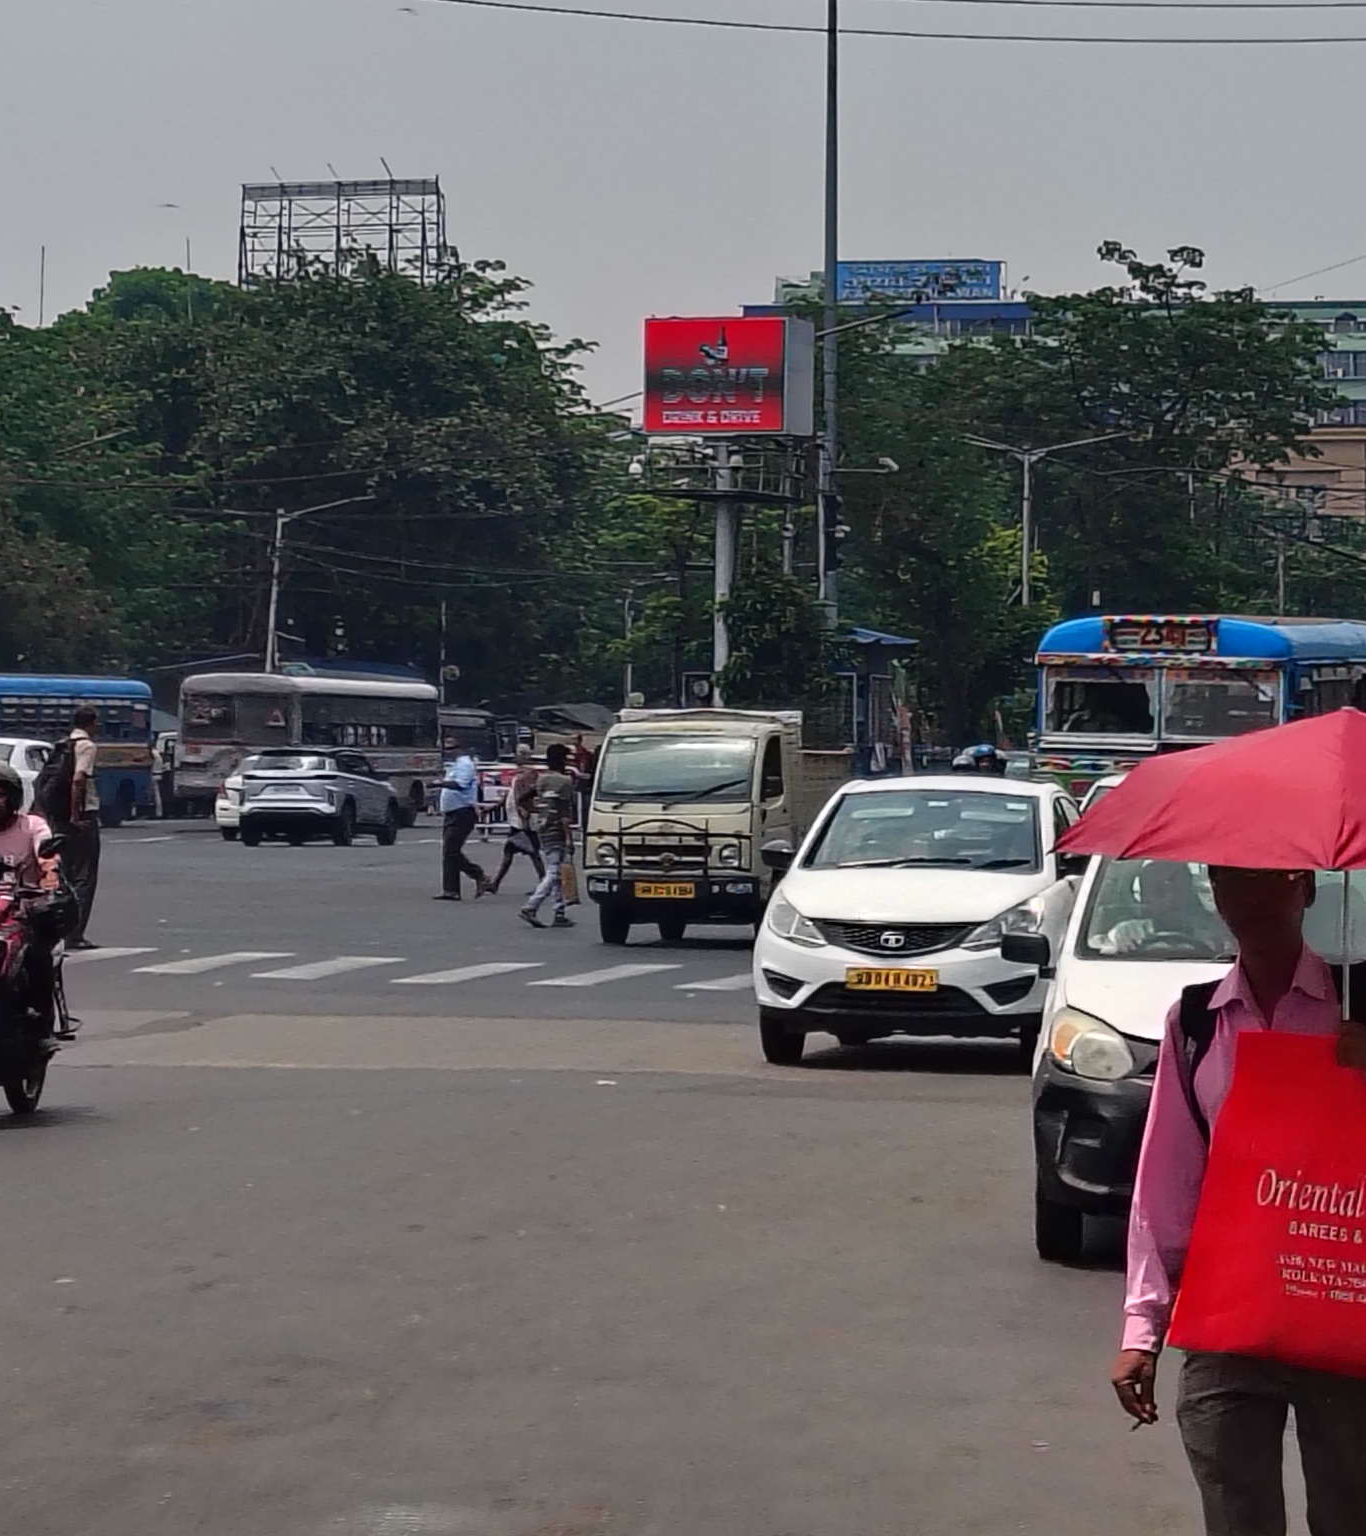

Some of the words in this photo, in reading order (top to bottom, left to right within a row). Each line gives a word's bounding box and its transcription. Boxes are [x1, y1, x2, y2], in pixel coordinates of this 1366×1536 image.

[661, 367, 769, 404] DON'T
[1256, 1168, 1366, 1218] Oriental
[1352, 1229, 1364, 1245] &
